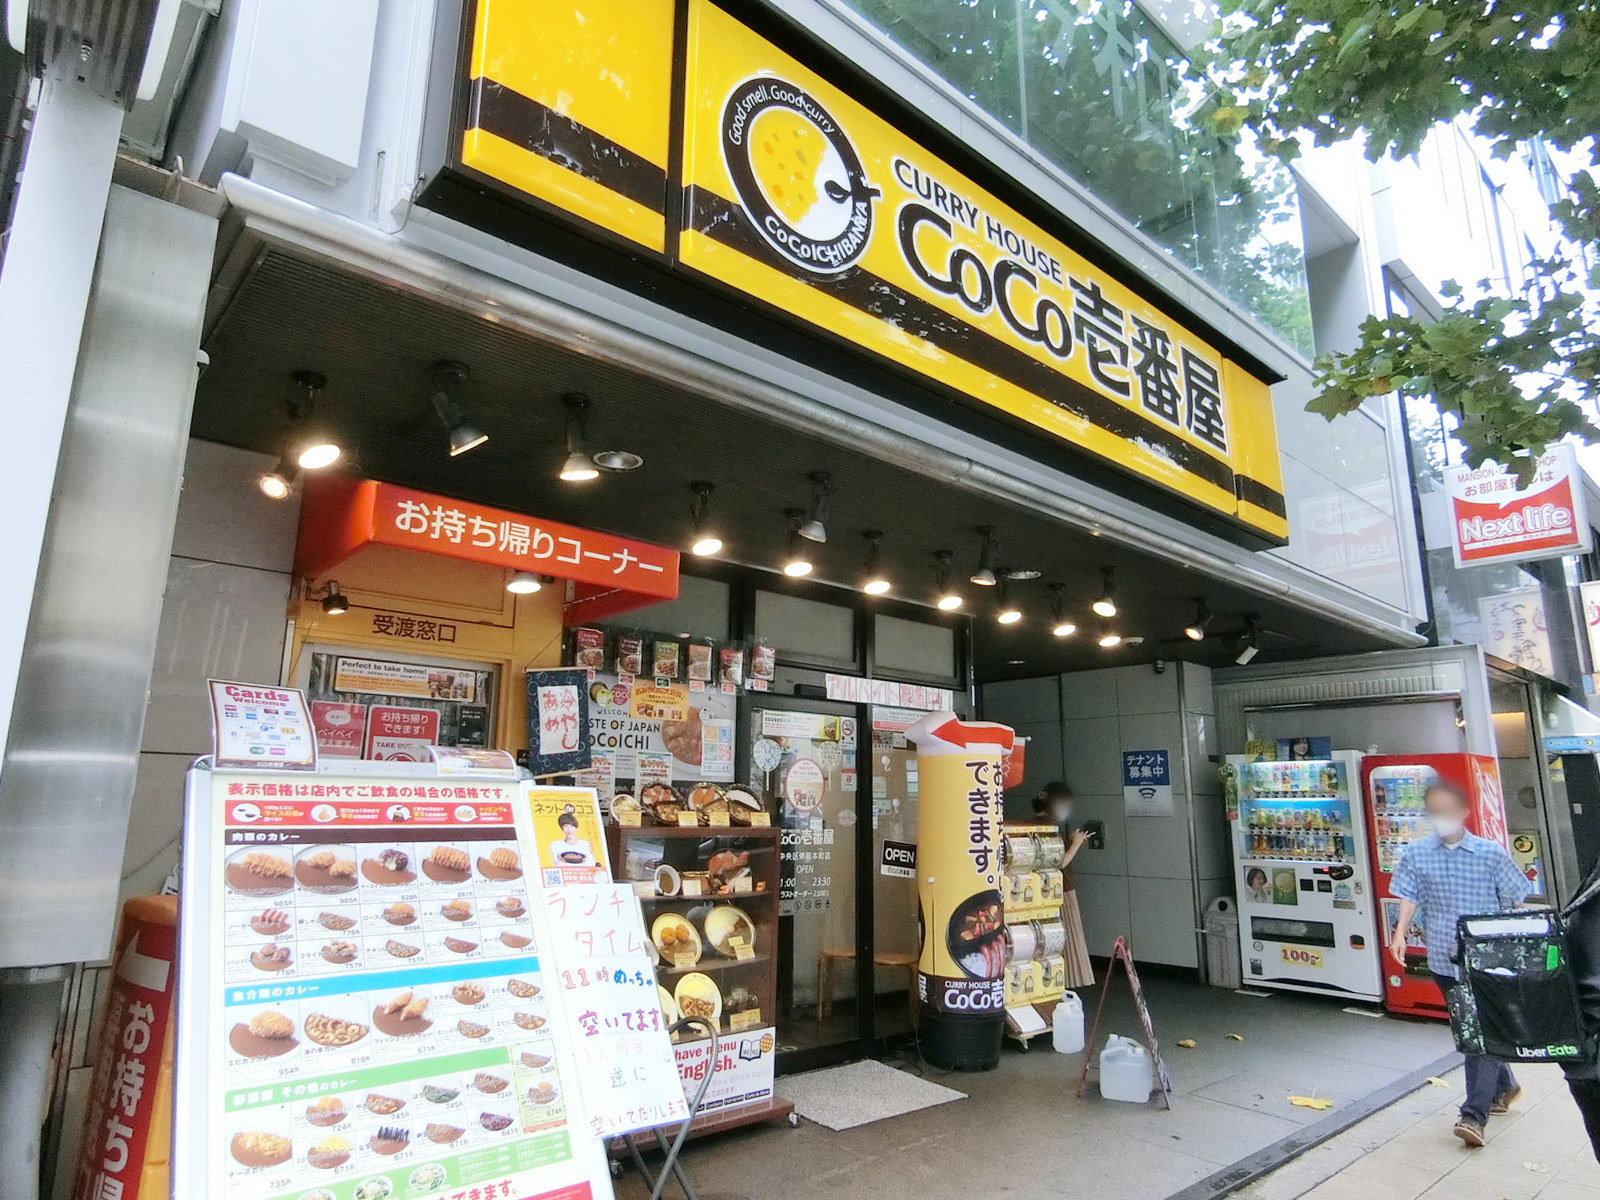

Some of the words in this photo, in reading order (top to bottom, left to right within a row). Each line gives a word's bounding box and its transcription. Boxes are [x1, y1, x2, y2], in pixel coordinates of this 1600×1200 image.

[729, 103, 746, 145] Good
[743, 85, 771, 111] smell.
[804, 103, 835, 134] curry
[894, 158, 979, 230] CURRY
[985, 217, 1062, 285] HOUSE
[1457, 467, 1495, 483] MANSION
[1535, 455, 1557, 468] HOP
[1465, 470, 1554, 497] お部屋は
[1459, 514, 1524, 544] Next
[1523, 504, 1572, 532] life
[394, 499, 664, 576] お持ち帰りコーナー
[372, 614, 458, 643] 受渡窓口
[341, 660, 372, 670] Perfect
[384, 665, 401, 673] take
[403, 666, 428, 675] home!
[225, 685, 290, 702] Cards
[232, 696, 287, 708] Welcome
[381, 711, 429, 724] お持ち帰り
[560, 688, 578, 750] 冷やし
[597, 708, 632, 718] WELCOM
[383, 723, 426, 736] できます!
[589, 718, 607, 730] STE
[610, 719, 625, 730] OF
[628, 721, 661, 733] JAPAN
[589, 733, 650, 750] oCoICHI
[1126, 754, 1165, 766] テナント
[1128, 766, 1164, 778] 募集中
[965, 760, 995, 885] できます。
[780, 828, 834, 845] oCo壱番屋
[885, 847, 915, 864] OPEN
[796, 864, 815, 874] OPEN
[548, 890, 625, 919] ランチ
[575, 928, 645, 958] タイム
[945, 980, 968, 989] CURRY
[968, 981, 991, 989] HOUSE
[578, 1008, 661, 1037] 空いてます
[674, 1047, 702, 1060] have
[1516, 1046, 1547, 1058] Uber
[1547, 1044, 1578, 1056] Eats
[677, 1055, 737, 1081] Englsh.
[589, 1099, 687, 1137] 空いてたりします
[438, 1179, 517, 1200] できます。
